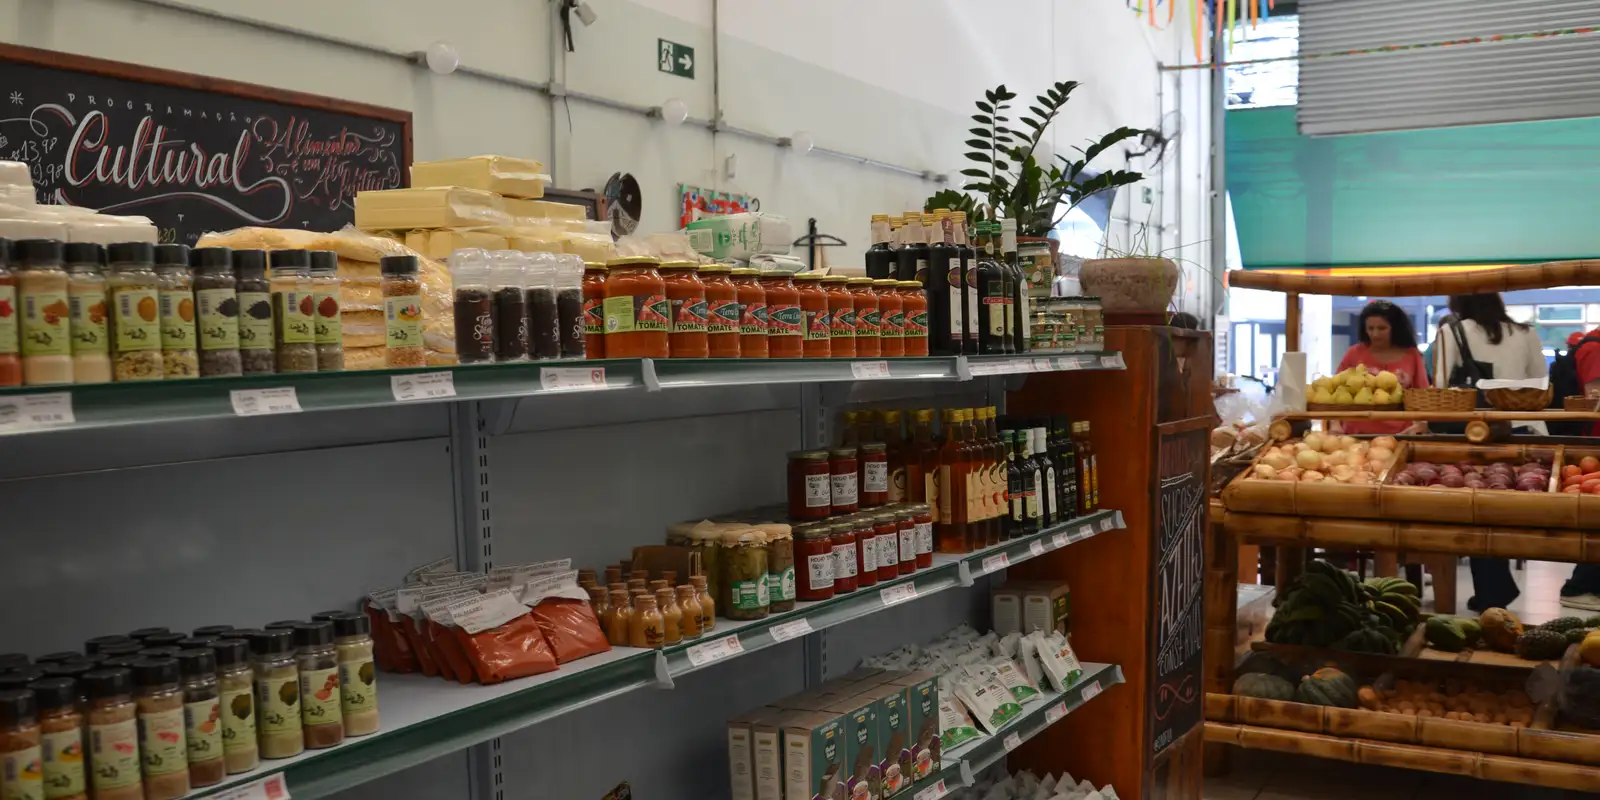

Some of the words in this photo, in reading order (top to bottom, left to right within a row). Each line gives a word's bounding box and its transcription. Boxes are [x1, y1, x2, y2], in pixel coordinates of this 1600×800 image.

[64, 108, 254, 190] Cultural
[677, 323, 705, 331] TOMATE
[777, 312, 792, 321] Terra
[1160, 484, 1193, 553] SUCOS
